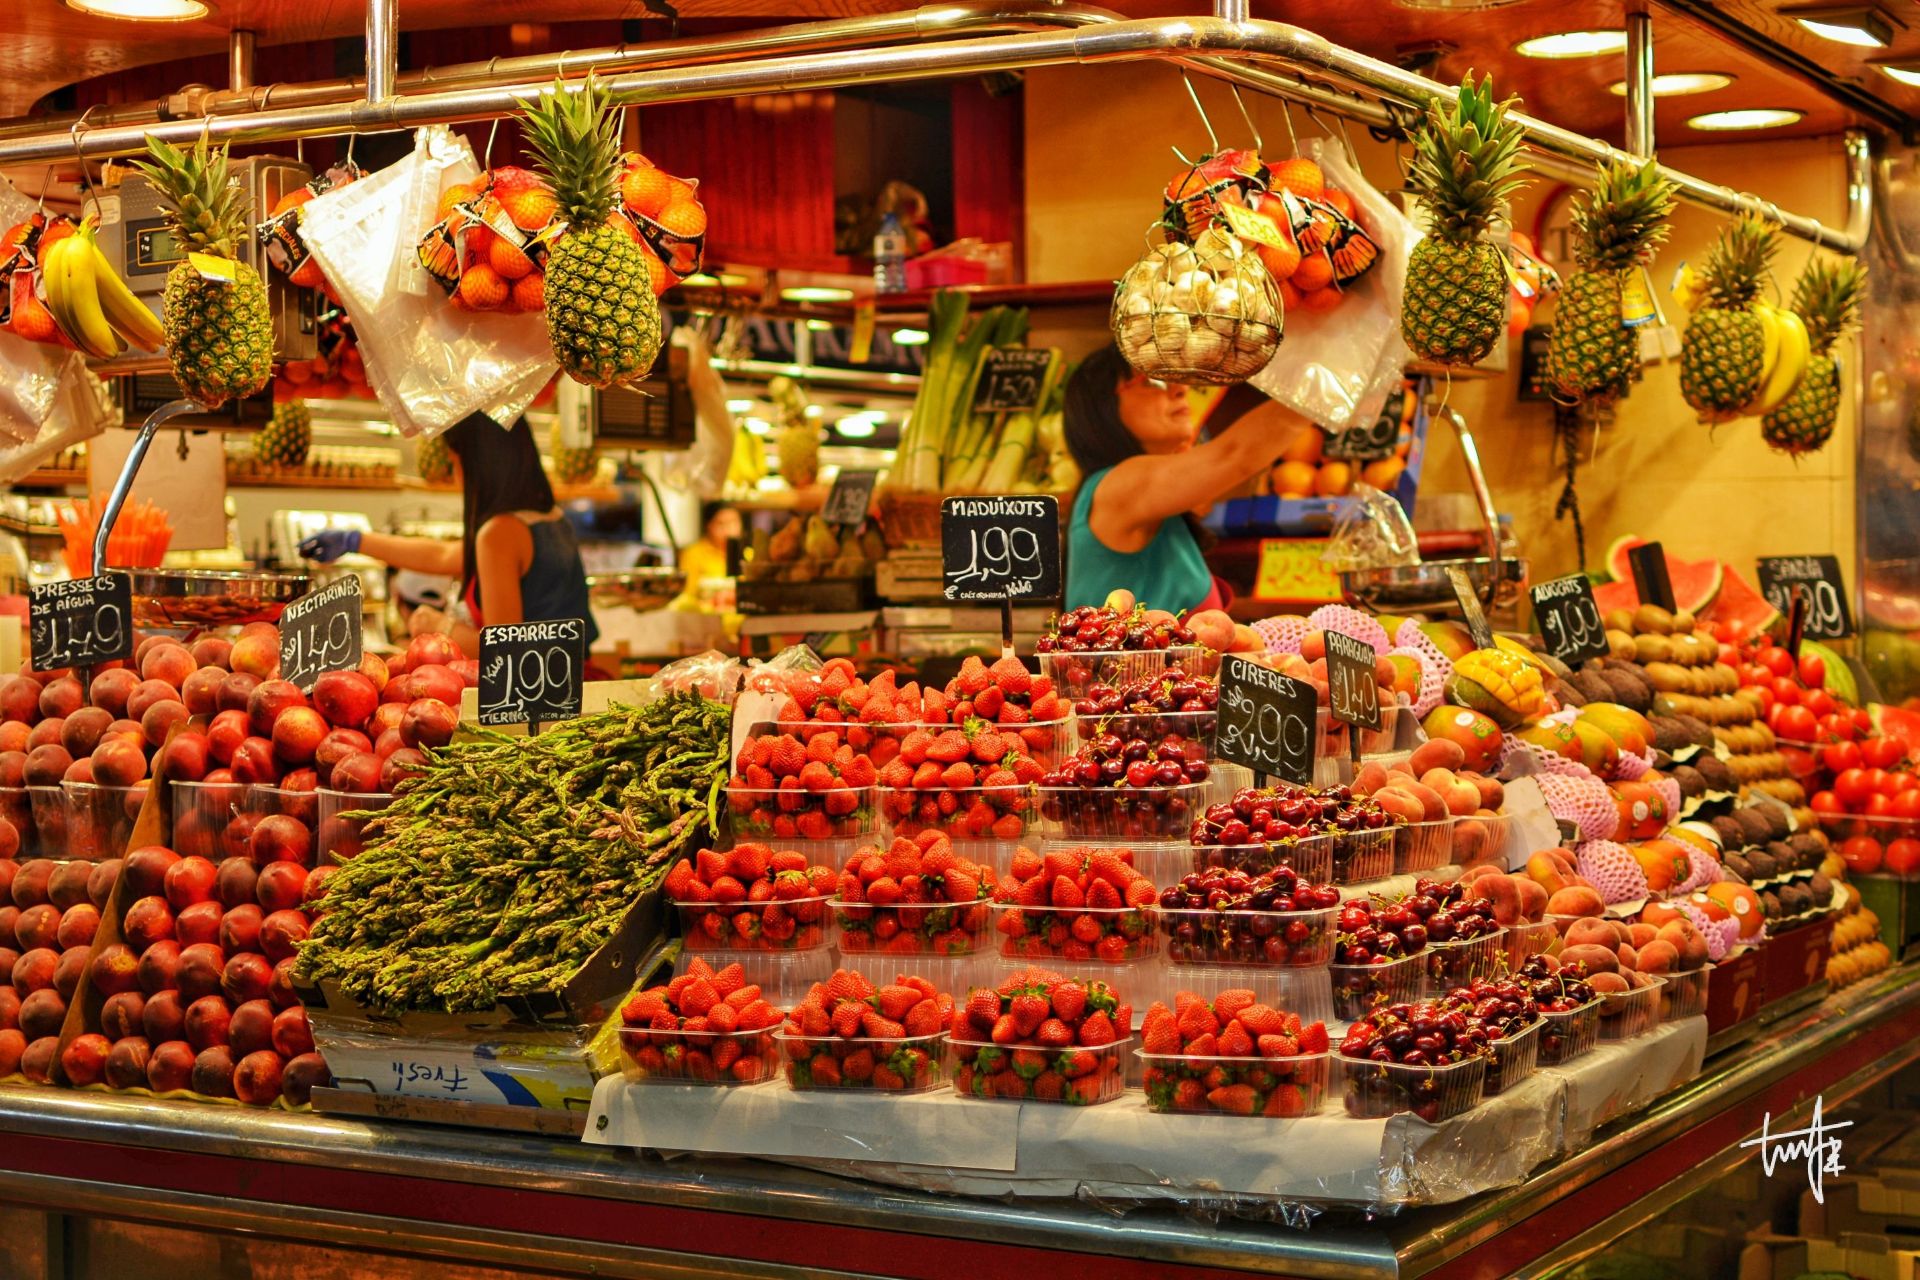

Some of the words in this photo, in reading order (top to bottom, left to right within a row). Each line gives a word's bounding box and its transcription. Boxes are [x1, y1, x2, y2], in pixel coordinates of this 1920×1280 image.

[946, 526, 1043, 583] 1,99
[31, 575, 116, 601] PRESSECS
[31, 602, 51, 616] DE
[34, 604, 123, 662] 1,49
[284, 611, 352, 684] 1,49
[484, 621, 580, 646] ESPARRECS
[480, 646, 579, 713] 1,99
